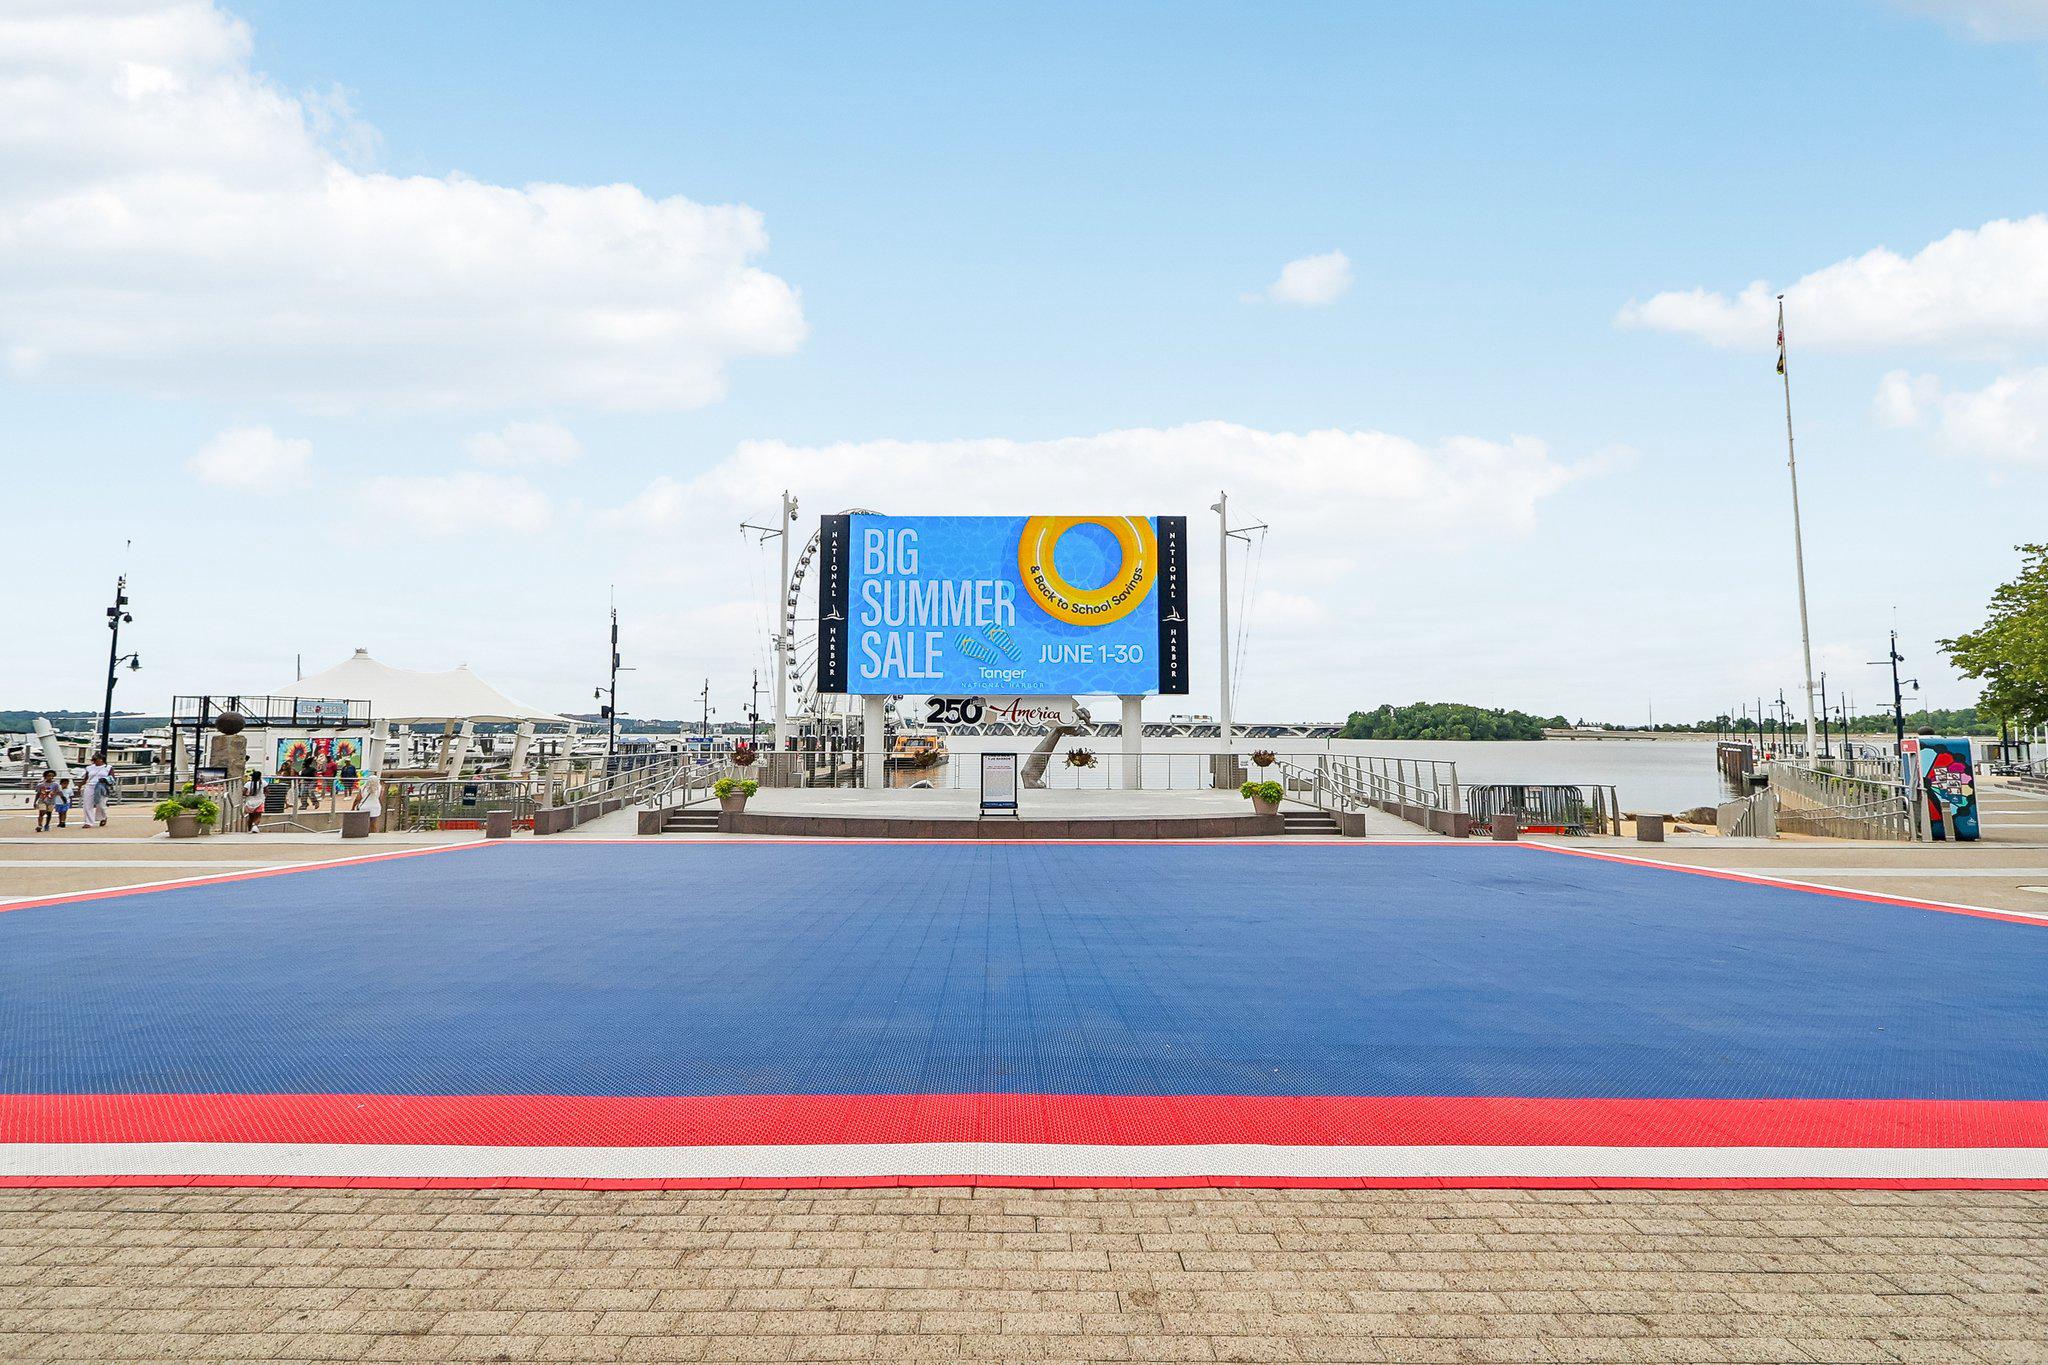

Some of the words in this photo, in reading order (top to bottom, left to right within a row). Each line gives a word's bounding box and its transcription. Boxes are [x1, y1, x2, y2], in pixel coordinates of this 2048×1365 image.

[830, 531, 838, 597] NATIONAL
[863, 528, 919, 575] BIG
[1169, 532, 1177, 598] NATIONAL
[1030, 565, 1040, 574] &
[1111, 567, 1143, 605] Savings
[860, 578, 1016, 627] SUMMER
[1033, 575, 1056, 602] Back
[1057, 598, 1069, 610] to
[1071, 600, 1112, 615] School
[860, 631, 944, 679] SALE
[1038, 644, 1094, 664] JUNE
[1097, 644, 1144, 664] 1-30
[1170, 629, 1178, 677] HARBOR
[978, 666, 1027, 682] Tanger
[926, 698, 983, 724] 250
[989, 697, 1074, 726] America
